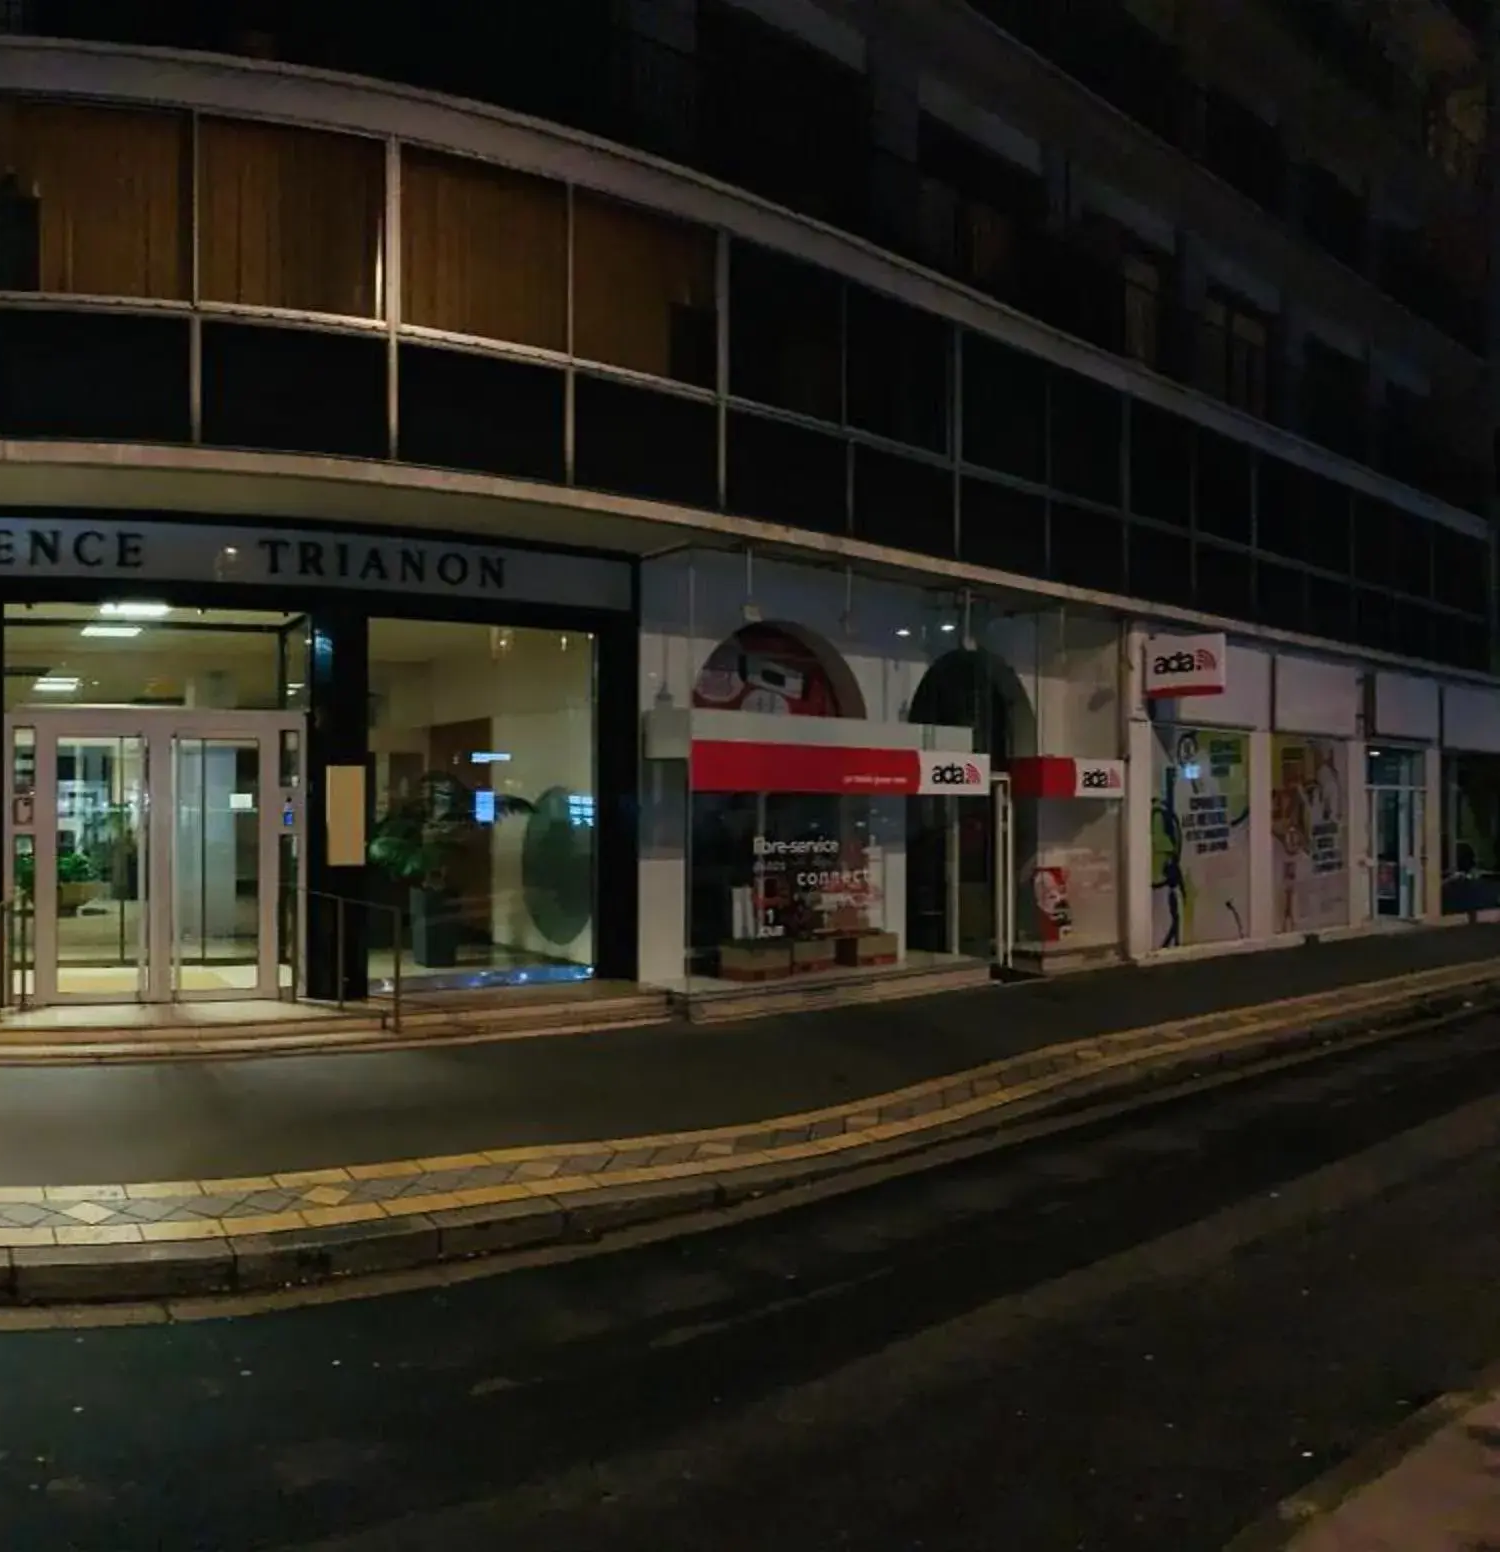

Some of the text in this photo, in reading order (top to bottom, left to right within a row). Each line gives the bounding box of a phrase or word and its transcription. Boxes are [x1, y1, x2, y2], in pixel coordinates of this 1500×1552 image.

[258, 538, 508, 589] TRIANON
[1153, 651, 1195, 675] ada
[931, 762, 966, 785] ada
[1082, 768, 1109, 788] ada
